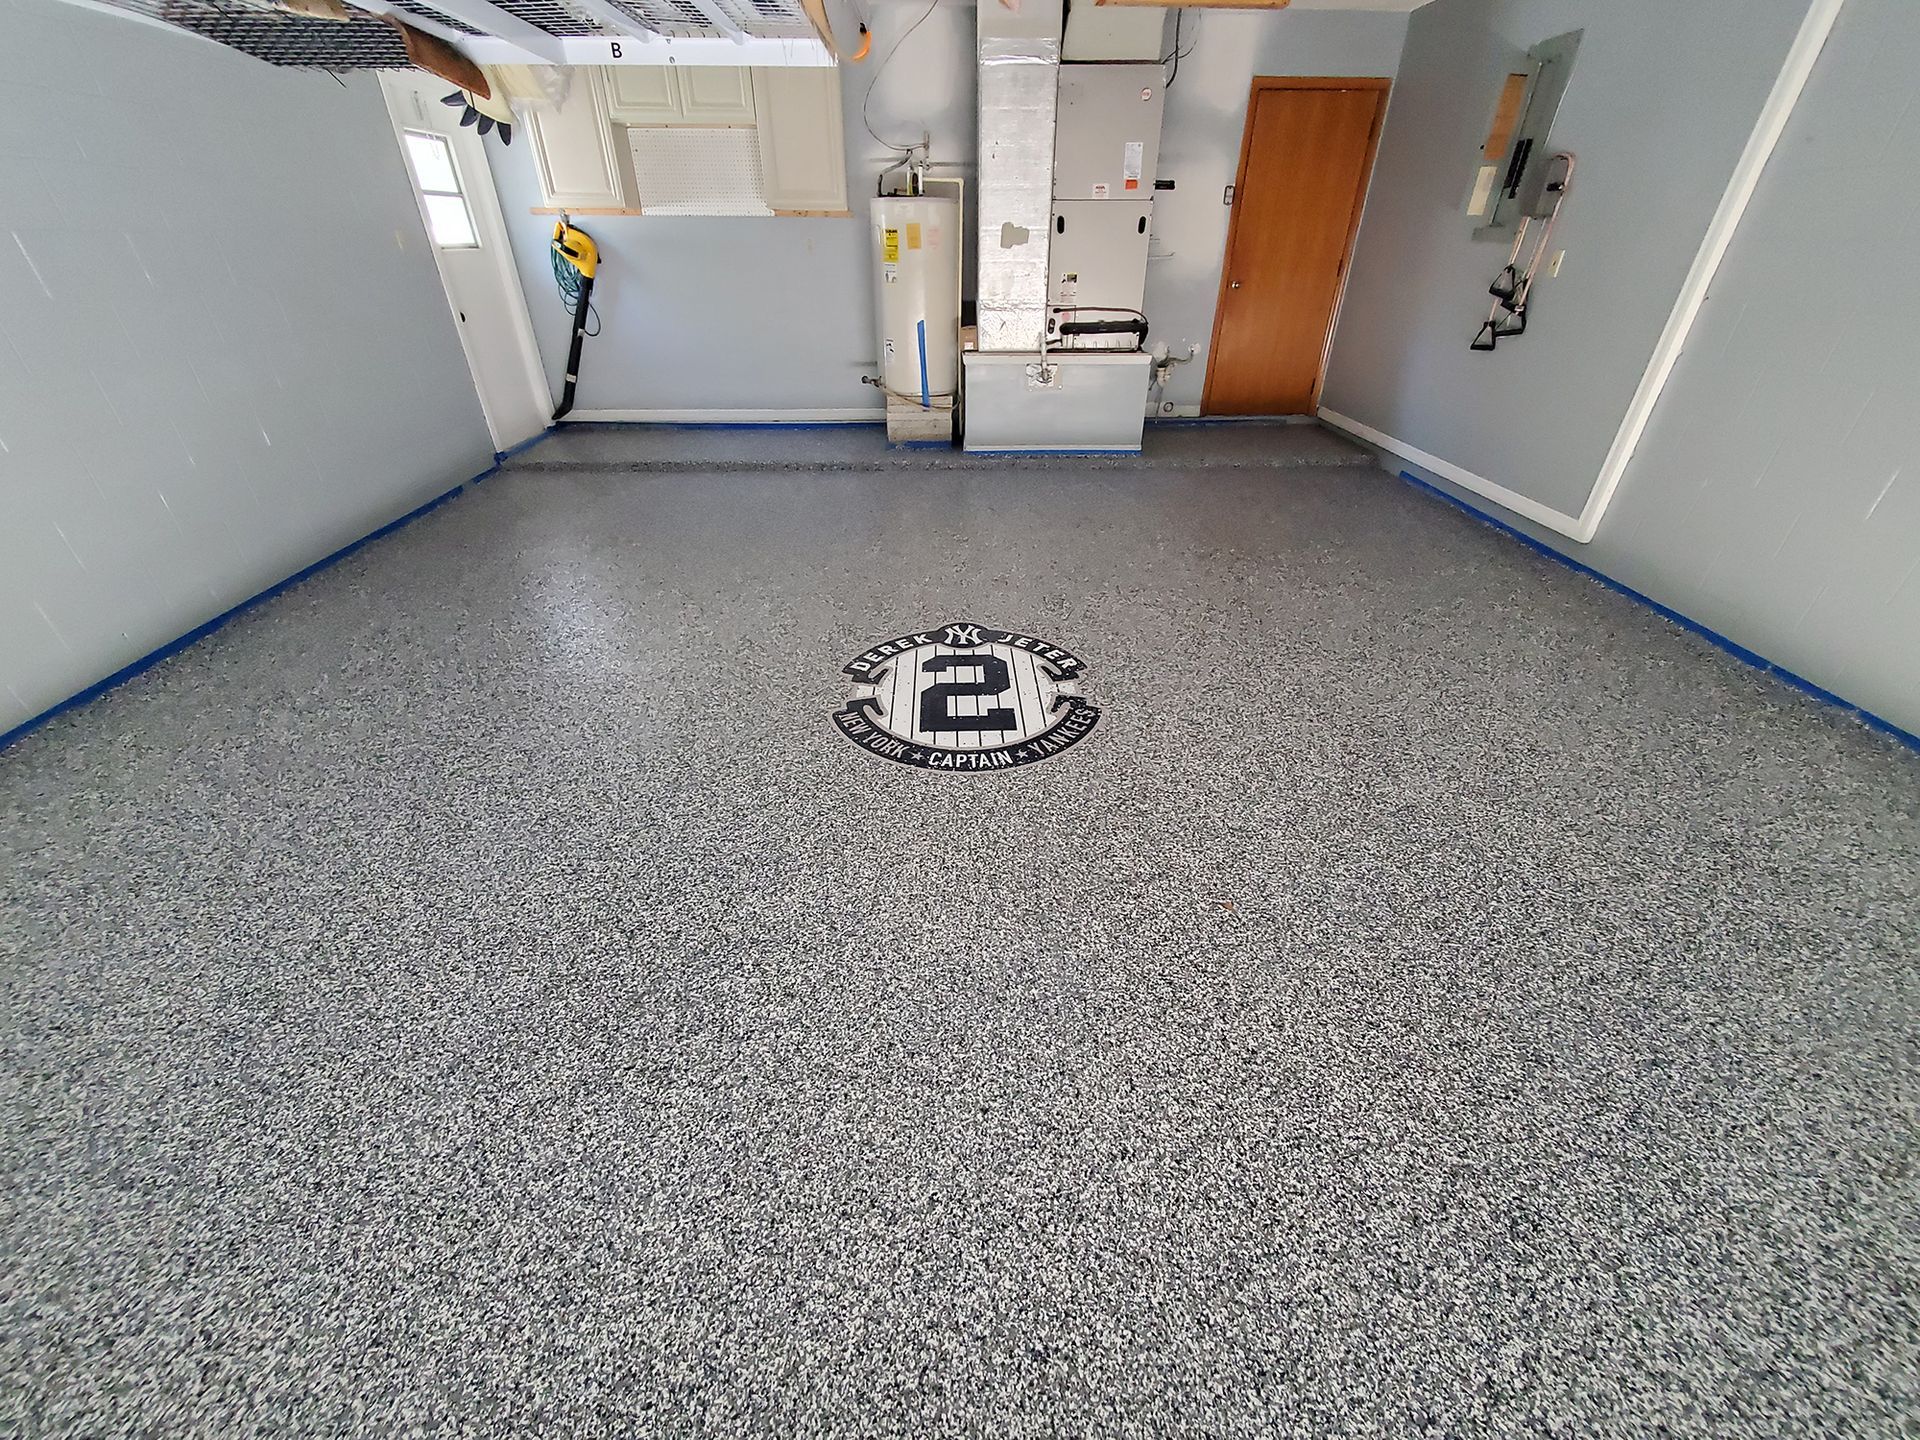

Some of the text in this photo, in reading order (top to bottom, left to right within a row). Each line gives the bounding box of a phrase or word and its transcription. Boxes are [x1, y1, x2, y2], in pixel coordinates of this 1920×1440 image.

[611, 42, 622, 58] B
[849, 634, 932, 672] DEREK
[998, 634, 1078, 669] JETER
[919, 654, 1018, 732] 2
[838, 707, 1097, 769] NEW YORK CAPTAIN YANKEES
